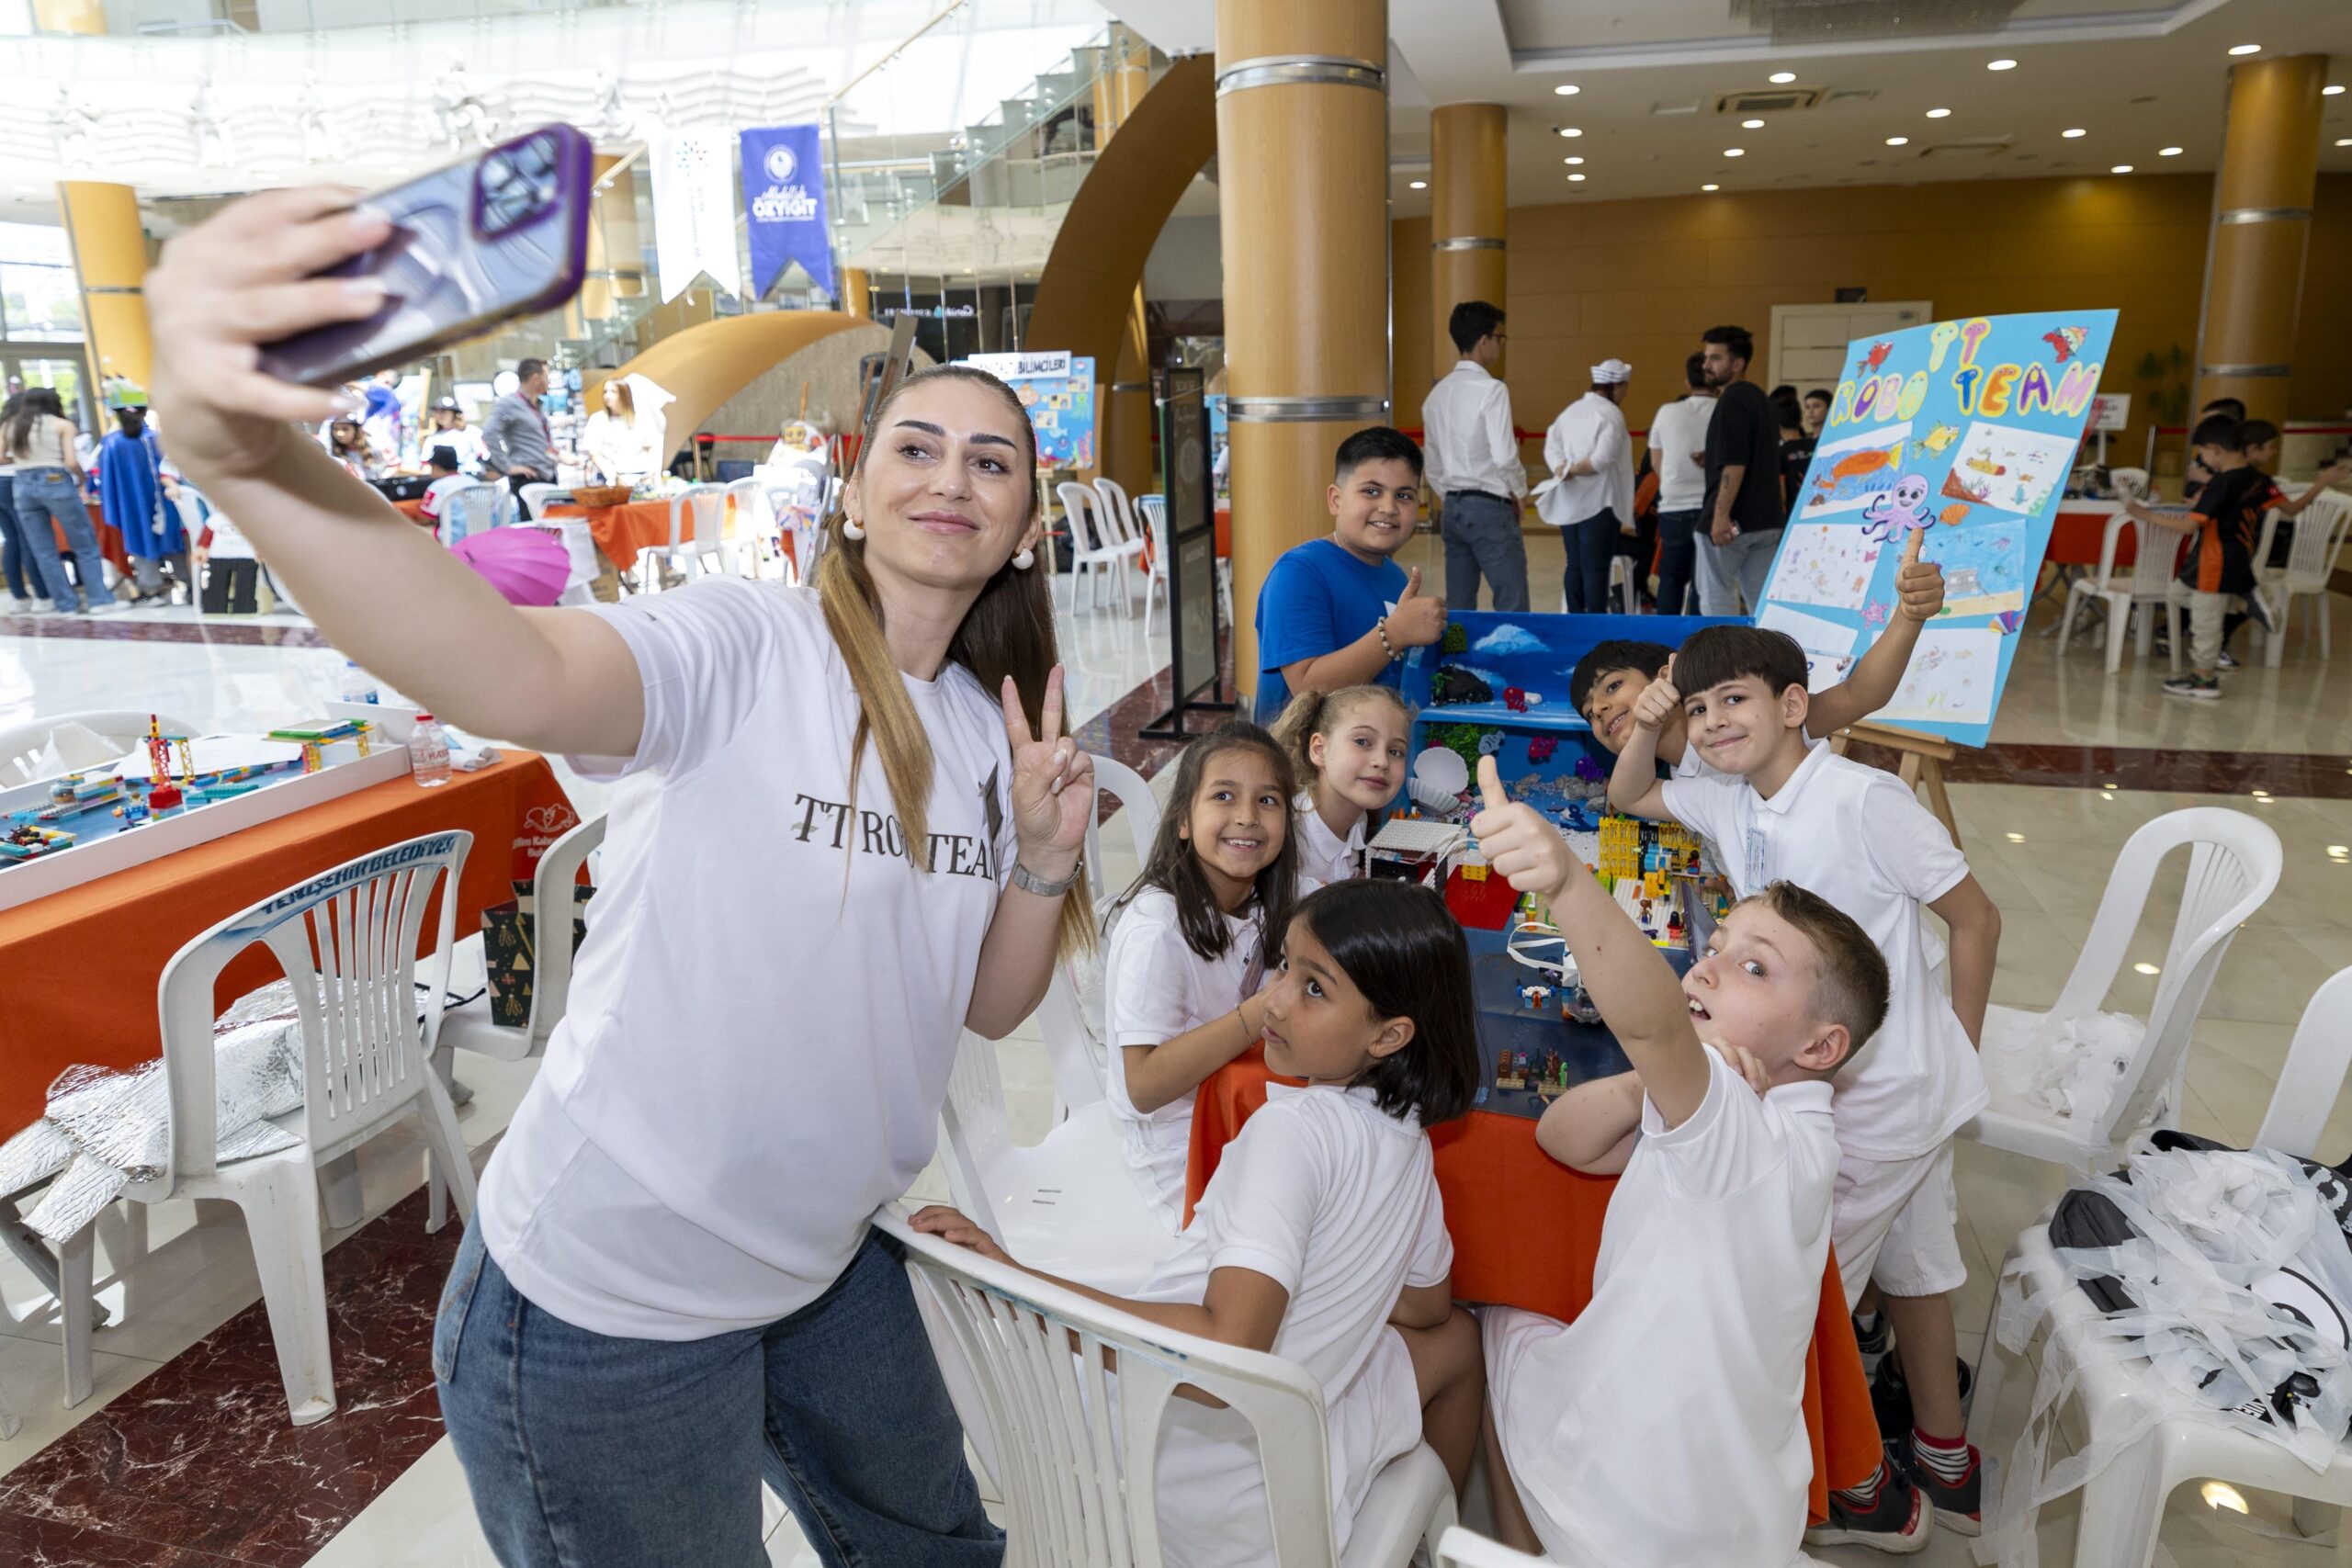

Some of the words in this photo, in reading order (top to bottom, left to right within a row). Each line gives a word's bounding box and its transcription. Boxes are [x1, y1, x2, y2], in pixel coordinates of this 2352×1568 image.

[1929, 318, 1991, 371] TT
[1830, 370, 1928, 426] ROBO
[1951, 362, 2101, 417] TEAM
[795, 794, 856, 849] TT
[860, 810, 915, 869] RO
